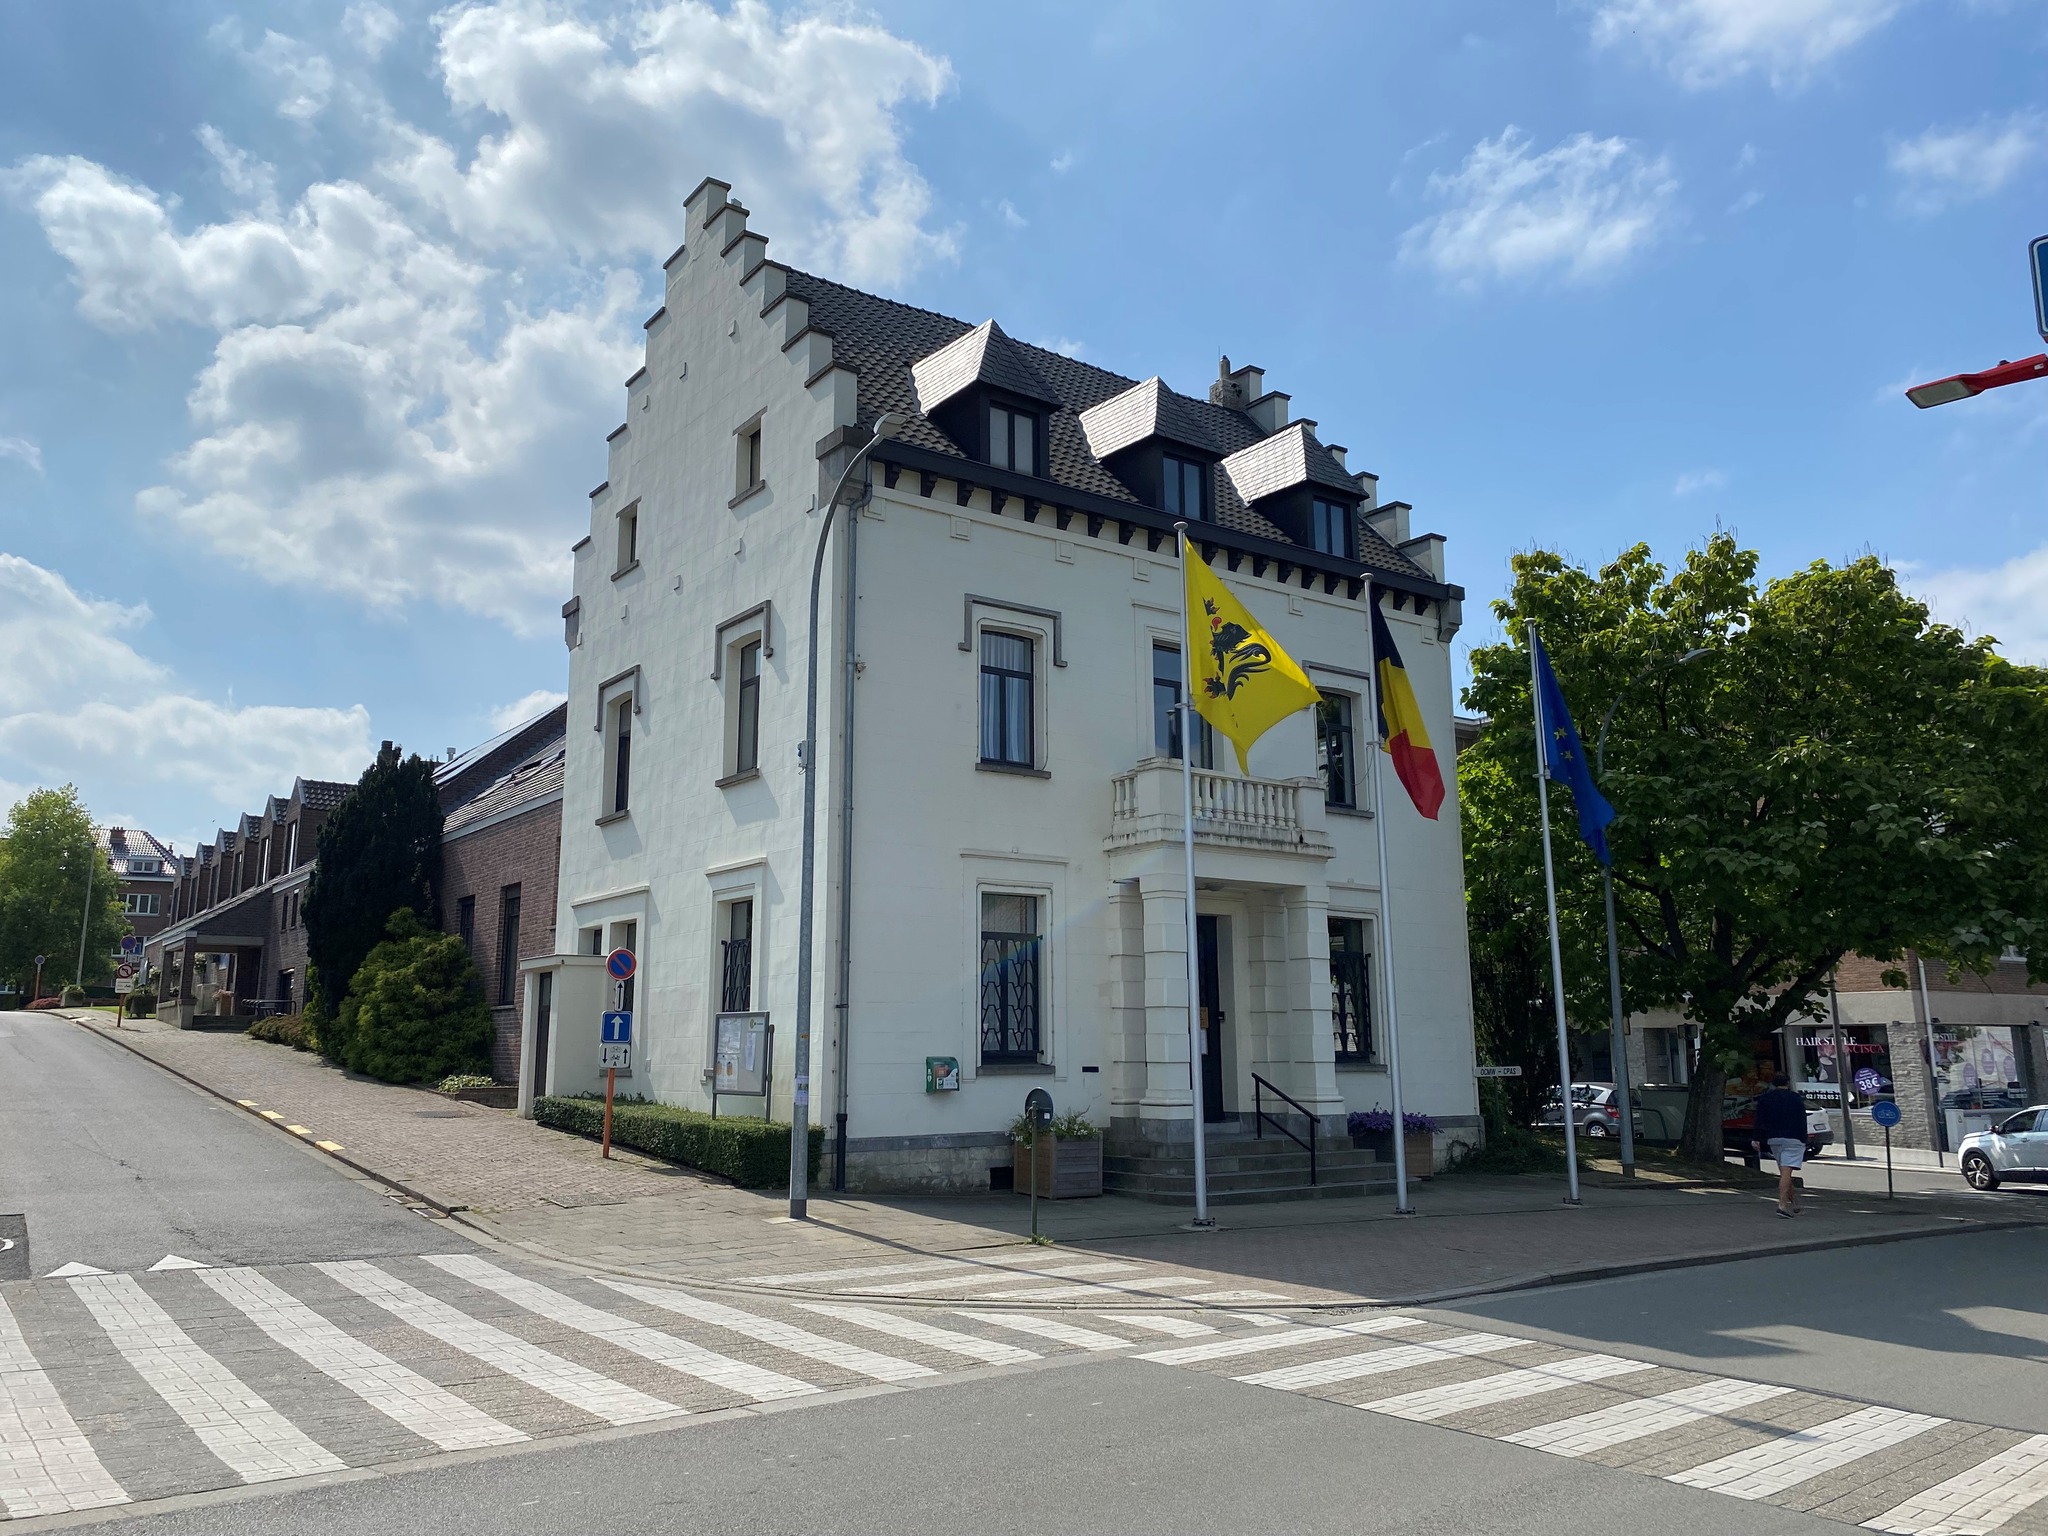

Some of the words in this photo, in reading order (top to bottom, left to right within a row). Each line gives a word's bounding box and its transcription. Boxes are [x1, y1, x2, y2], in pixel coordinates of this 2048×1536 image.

[1796, 1037, 1821, 1046] HAIR
[1823, 1037, 1857, 1046] STLE
[1859, 1077, 1880, 1090] 38€
